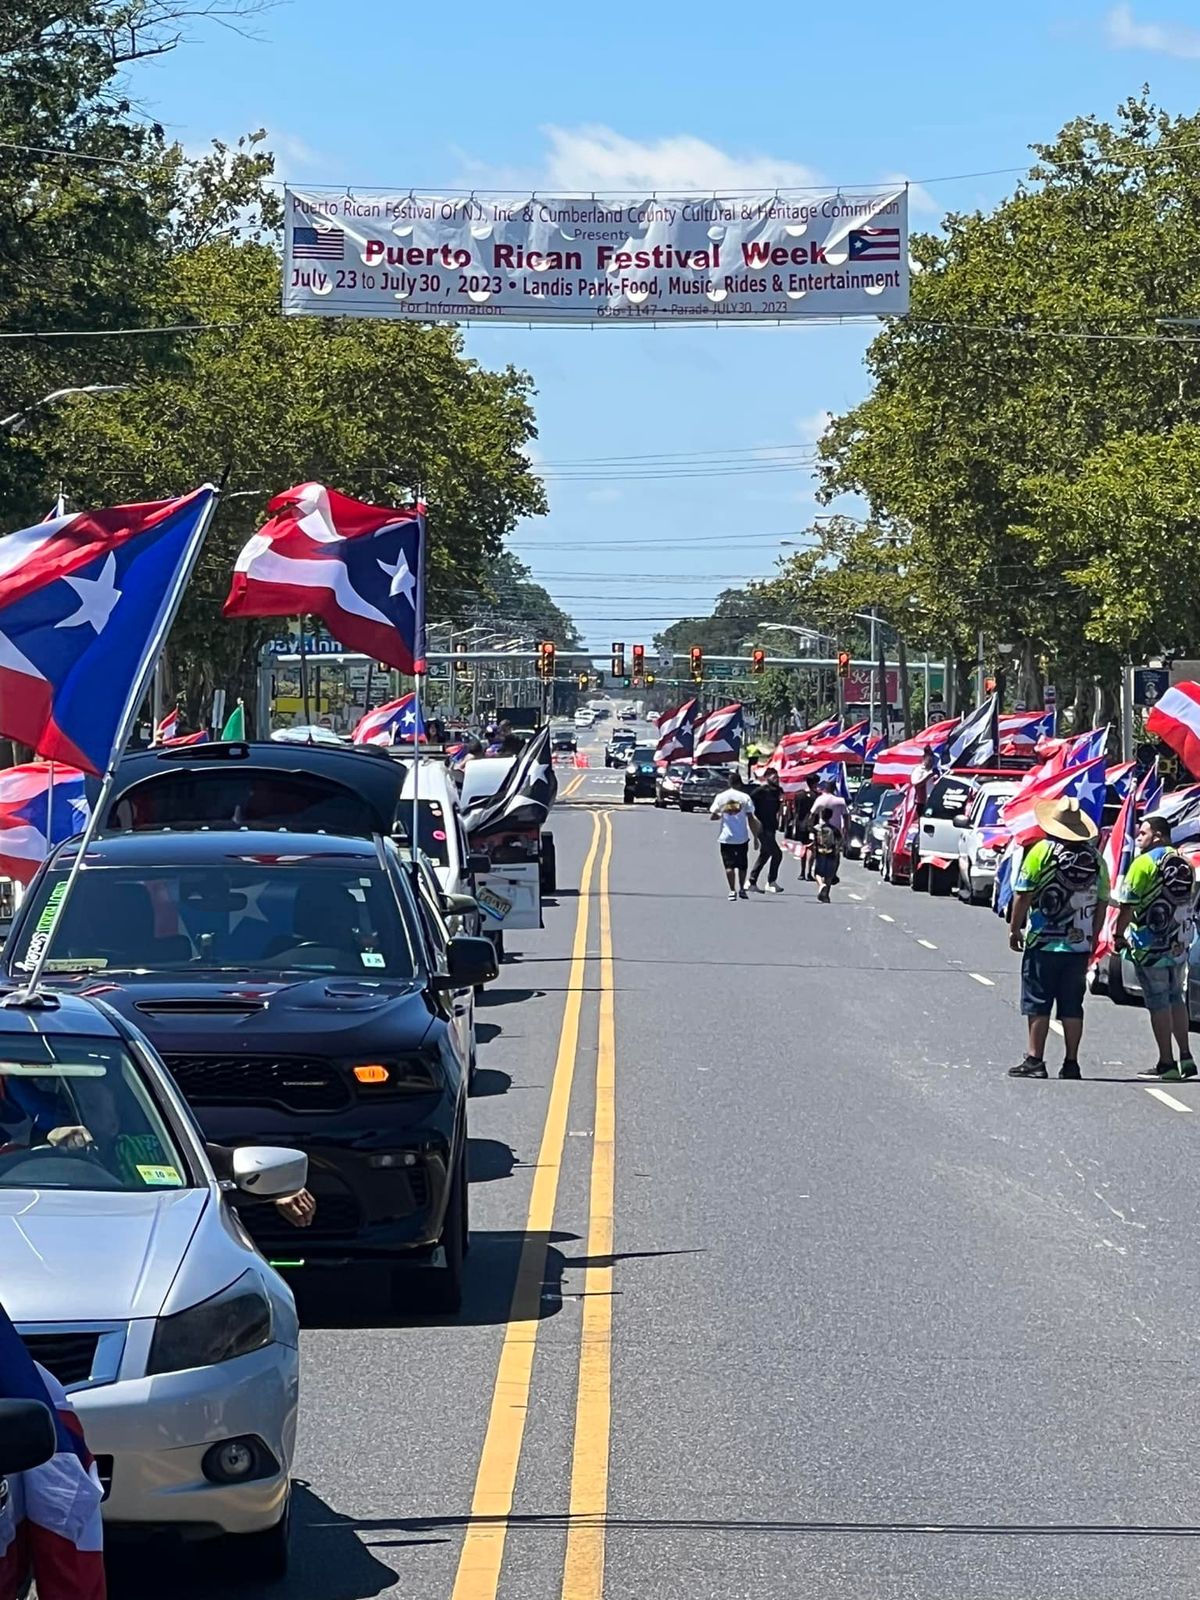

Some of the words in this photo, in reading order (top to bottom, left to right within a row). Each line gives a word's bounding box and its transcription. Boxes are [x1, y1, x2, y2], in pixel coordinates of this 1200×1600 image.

[292, 198, 338, 216] Puerto
[343, 200, 380, 217] Rican
[385, 202, 435, 220] Festival
[441, 203, 458, 220] Of
[522, 206, 534, 222] &
[539, 206, 623, 224] Cumberland
[628, 207, 676, 227] County
[681, 204, 736, 223] Cultural
[740, 204, 753, 220] &
[758, 203, 818, 224] Heritage
[574, 228, 630, 241] Presents
[365, 240, 472, 268] Puerto
[493, 243, 582, 271] Rican
[596, 242, 720, 271] Festival
[741, 240, 828, 267] Week
[291, 268, 328, 291] July
[335, 270, 358, 289] 23
[361, 271, 376, 290] to
[458, 275, 502, 294] 2023
[523, 276, 573, 296] Landis
[724, 274, 768, 294] Rides
[772, 275, 783, 291] &
[788, 270, 900, 292] Entertainment
[401, 301, 421, 313] For
[670, 303, 710, 316] Parade
[761, 301, 788, 314] 2023
[311, 637, 343, 653] Inn
